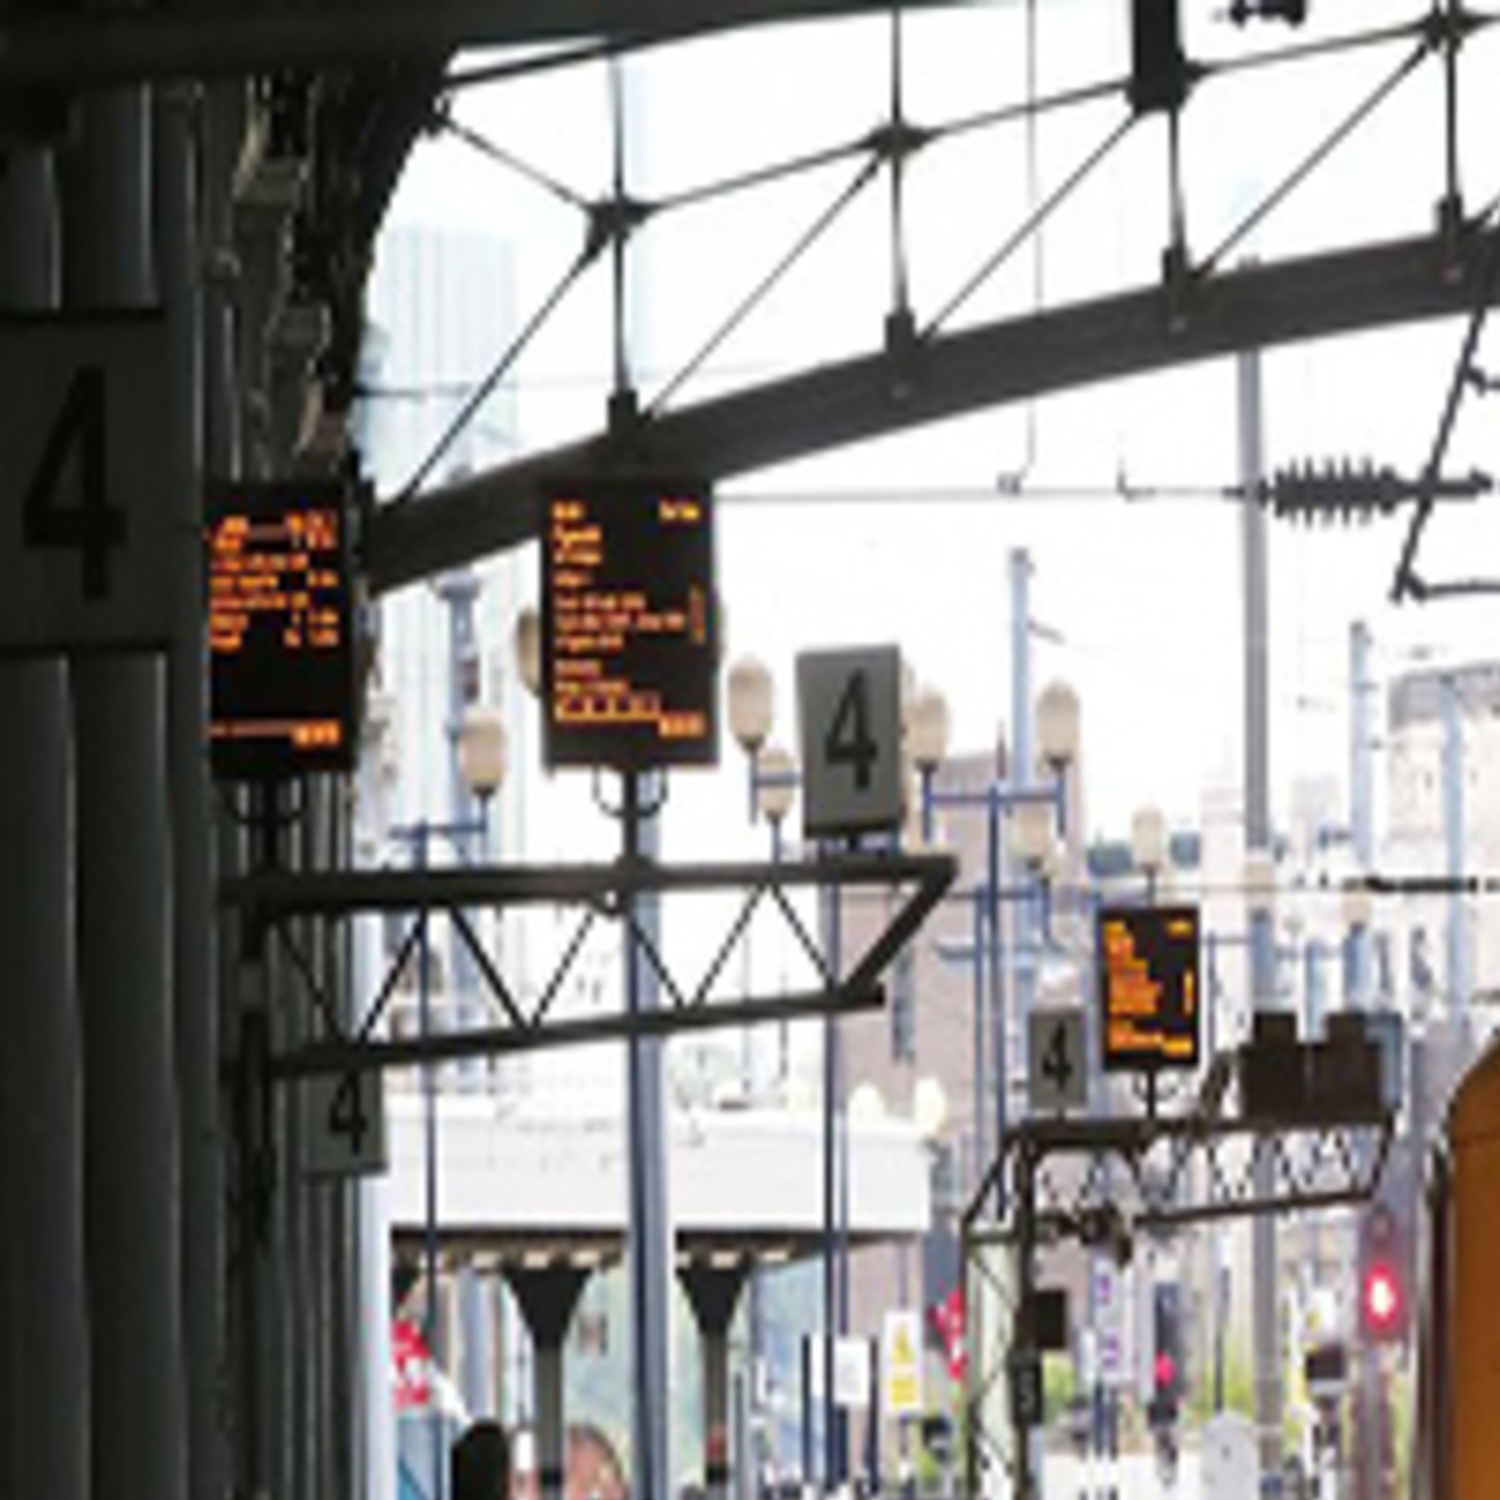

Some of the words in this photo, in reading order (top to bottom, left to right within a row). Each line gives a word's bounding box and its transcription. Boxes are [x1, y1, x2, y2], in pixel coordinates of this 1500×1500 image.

[23, 364, 127, 600] 4
[824, 668, 877, 790] 4
[1042, 1020, 1073, 1091] 4
[329, 1069, 368, 1156] 4
